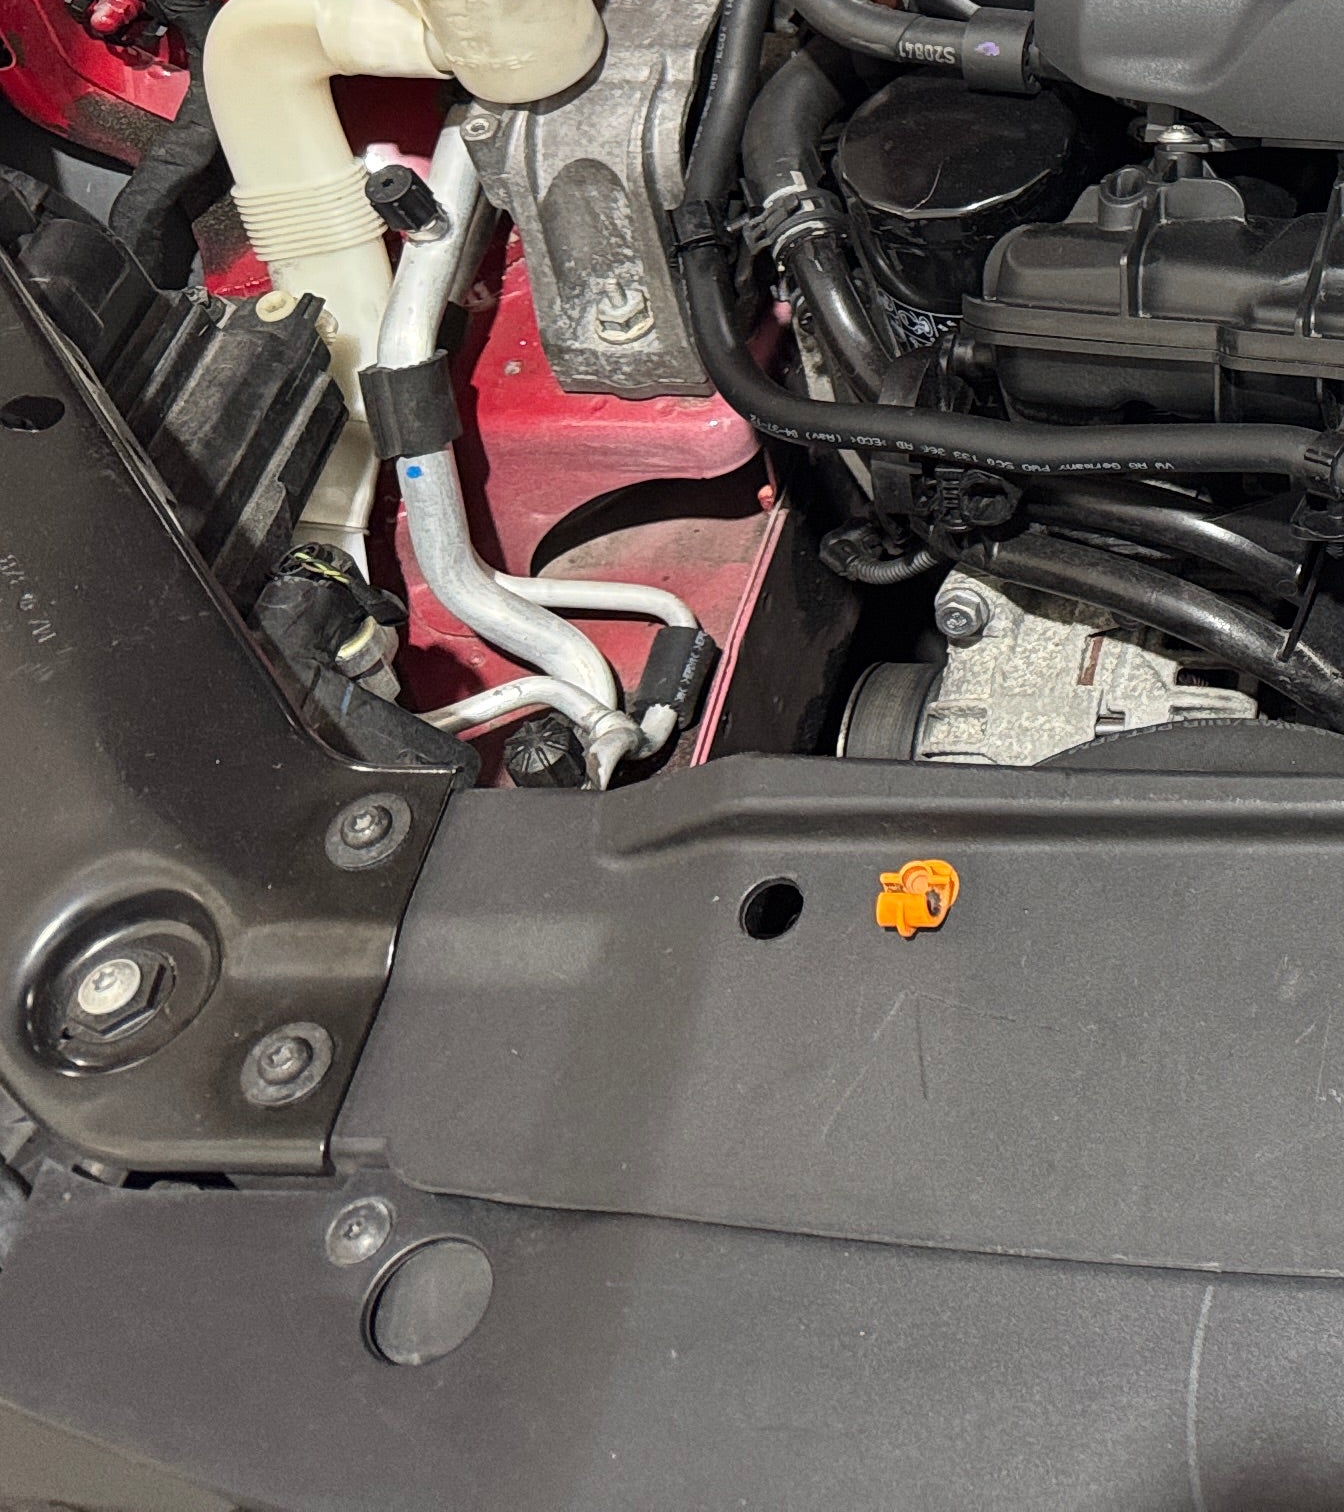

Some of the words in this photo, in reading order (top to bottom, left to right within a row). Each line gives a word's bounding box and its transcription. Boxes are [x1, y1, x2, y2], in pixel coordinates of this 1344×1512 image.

[898, 40, 956, 66] S20841
[895, 440, 914, 451] AD
[952, 451, 978, 463] 133
